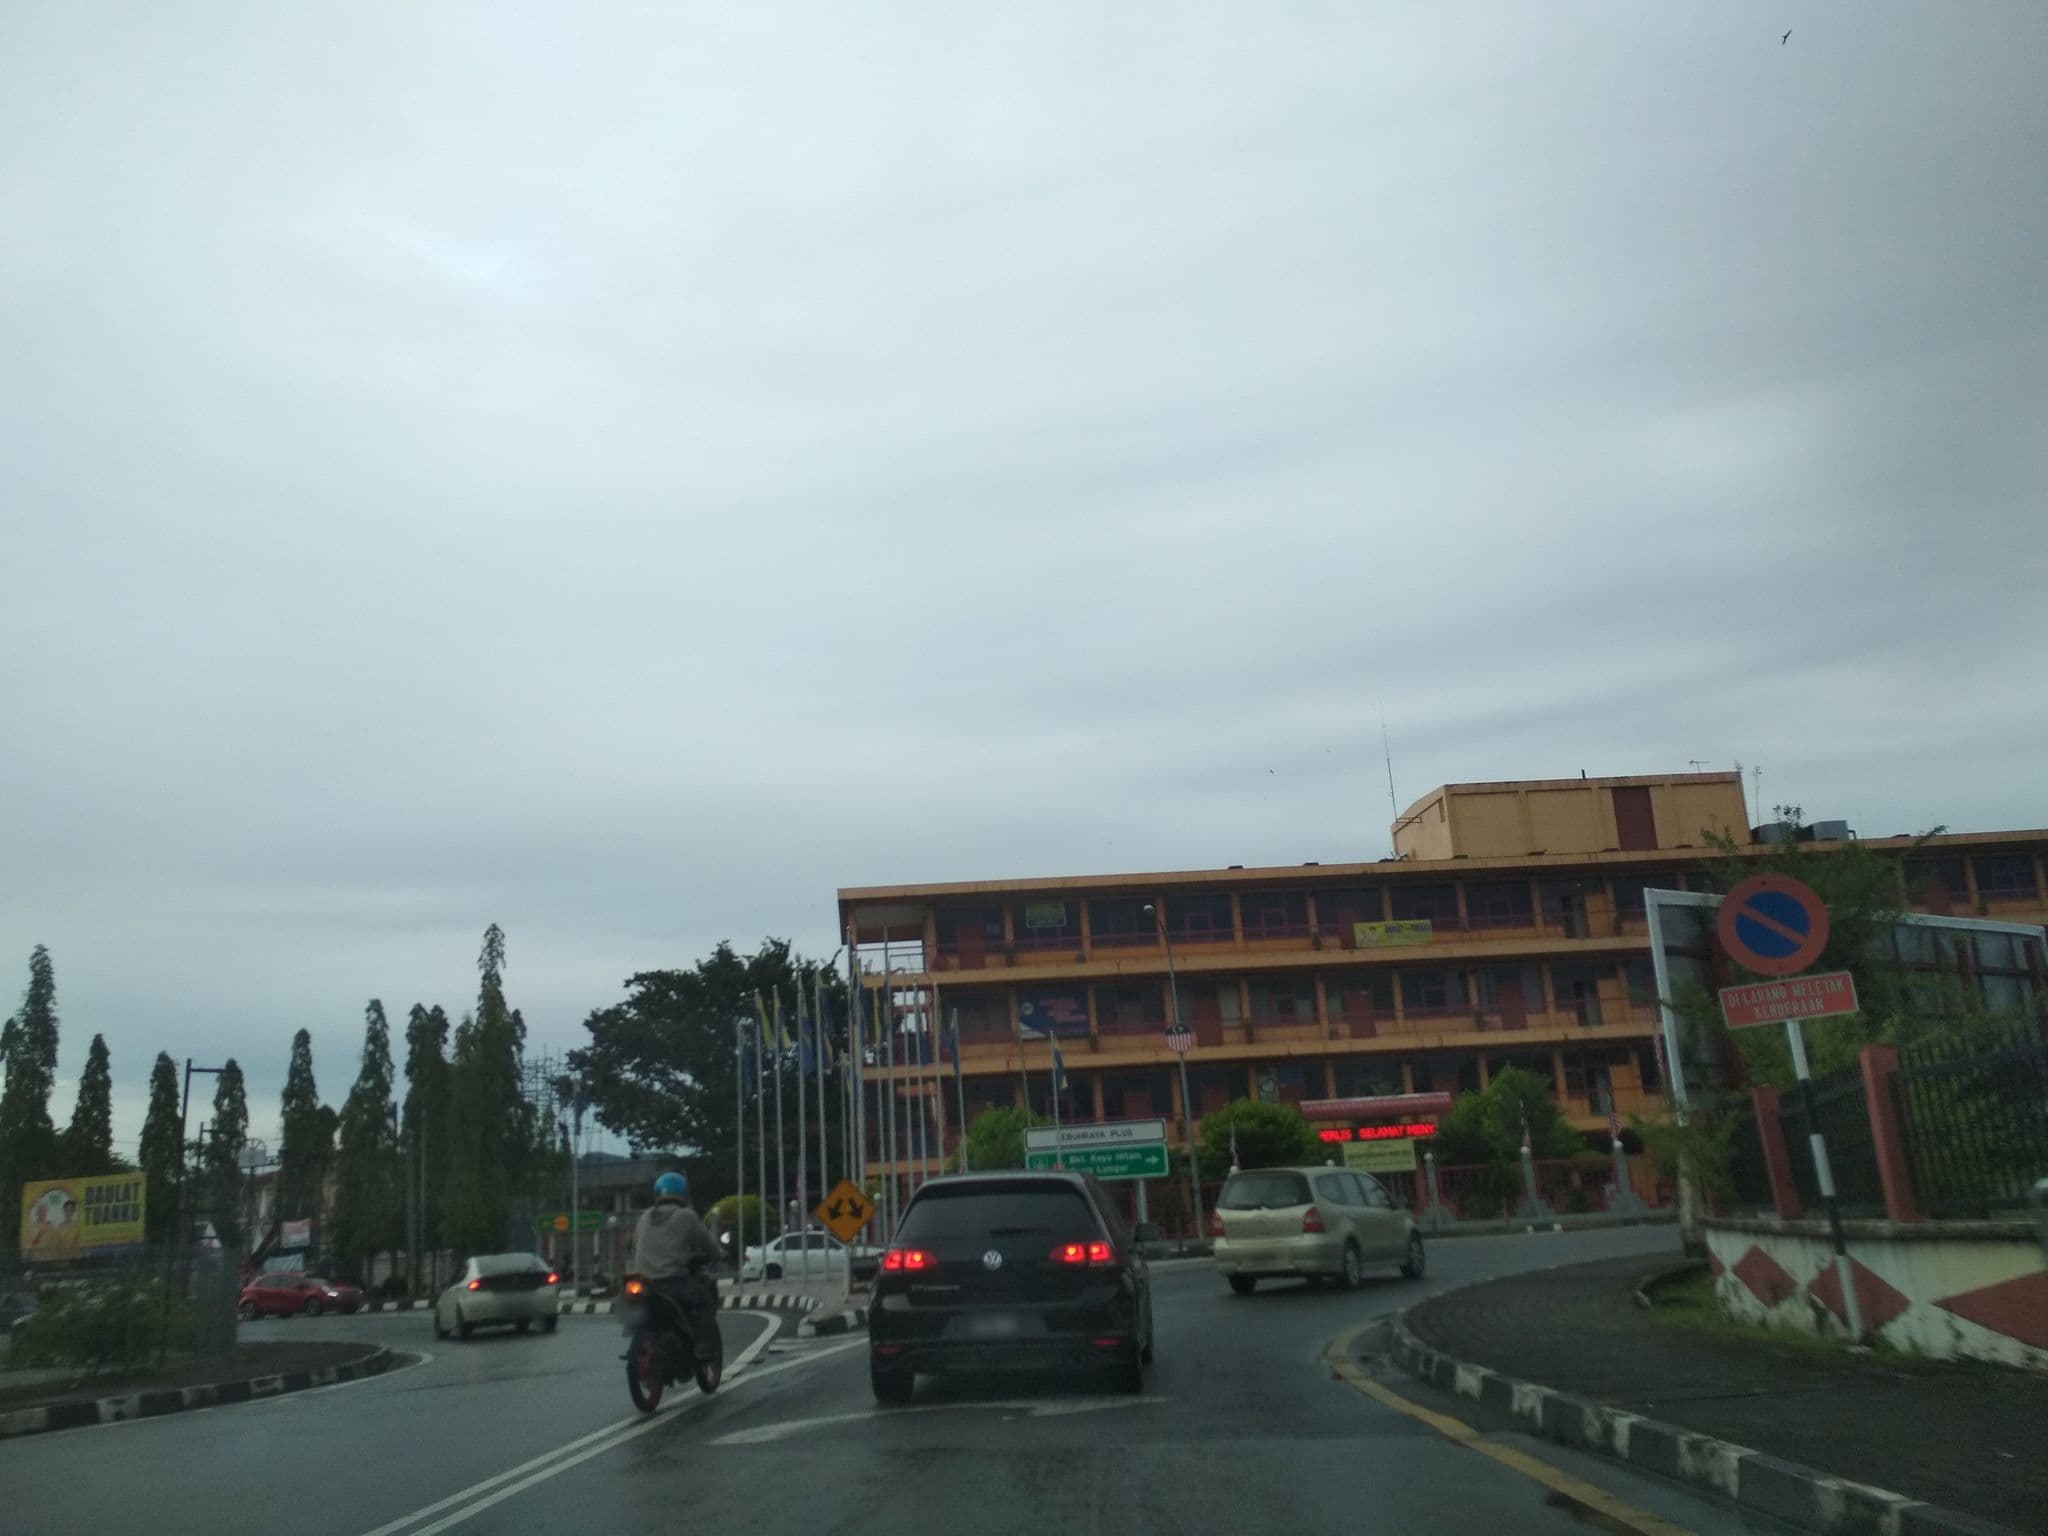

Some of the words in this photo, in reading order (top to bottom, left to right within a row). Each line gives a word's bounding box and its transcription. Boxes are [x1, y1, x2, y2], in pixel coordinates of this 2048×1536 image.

[1110, 1127, 1133, 1138] PLUS
[1359, 1125, 1404, 1140] SELAMAT
[85, 1182, 142, 1206] DAULAT
